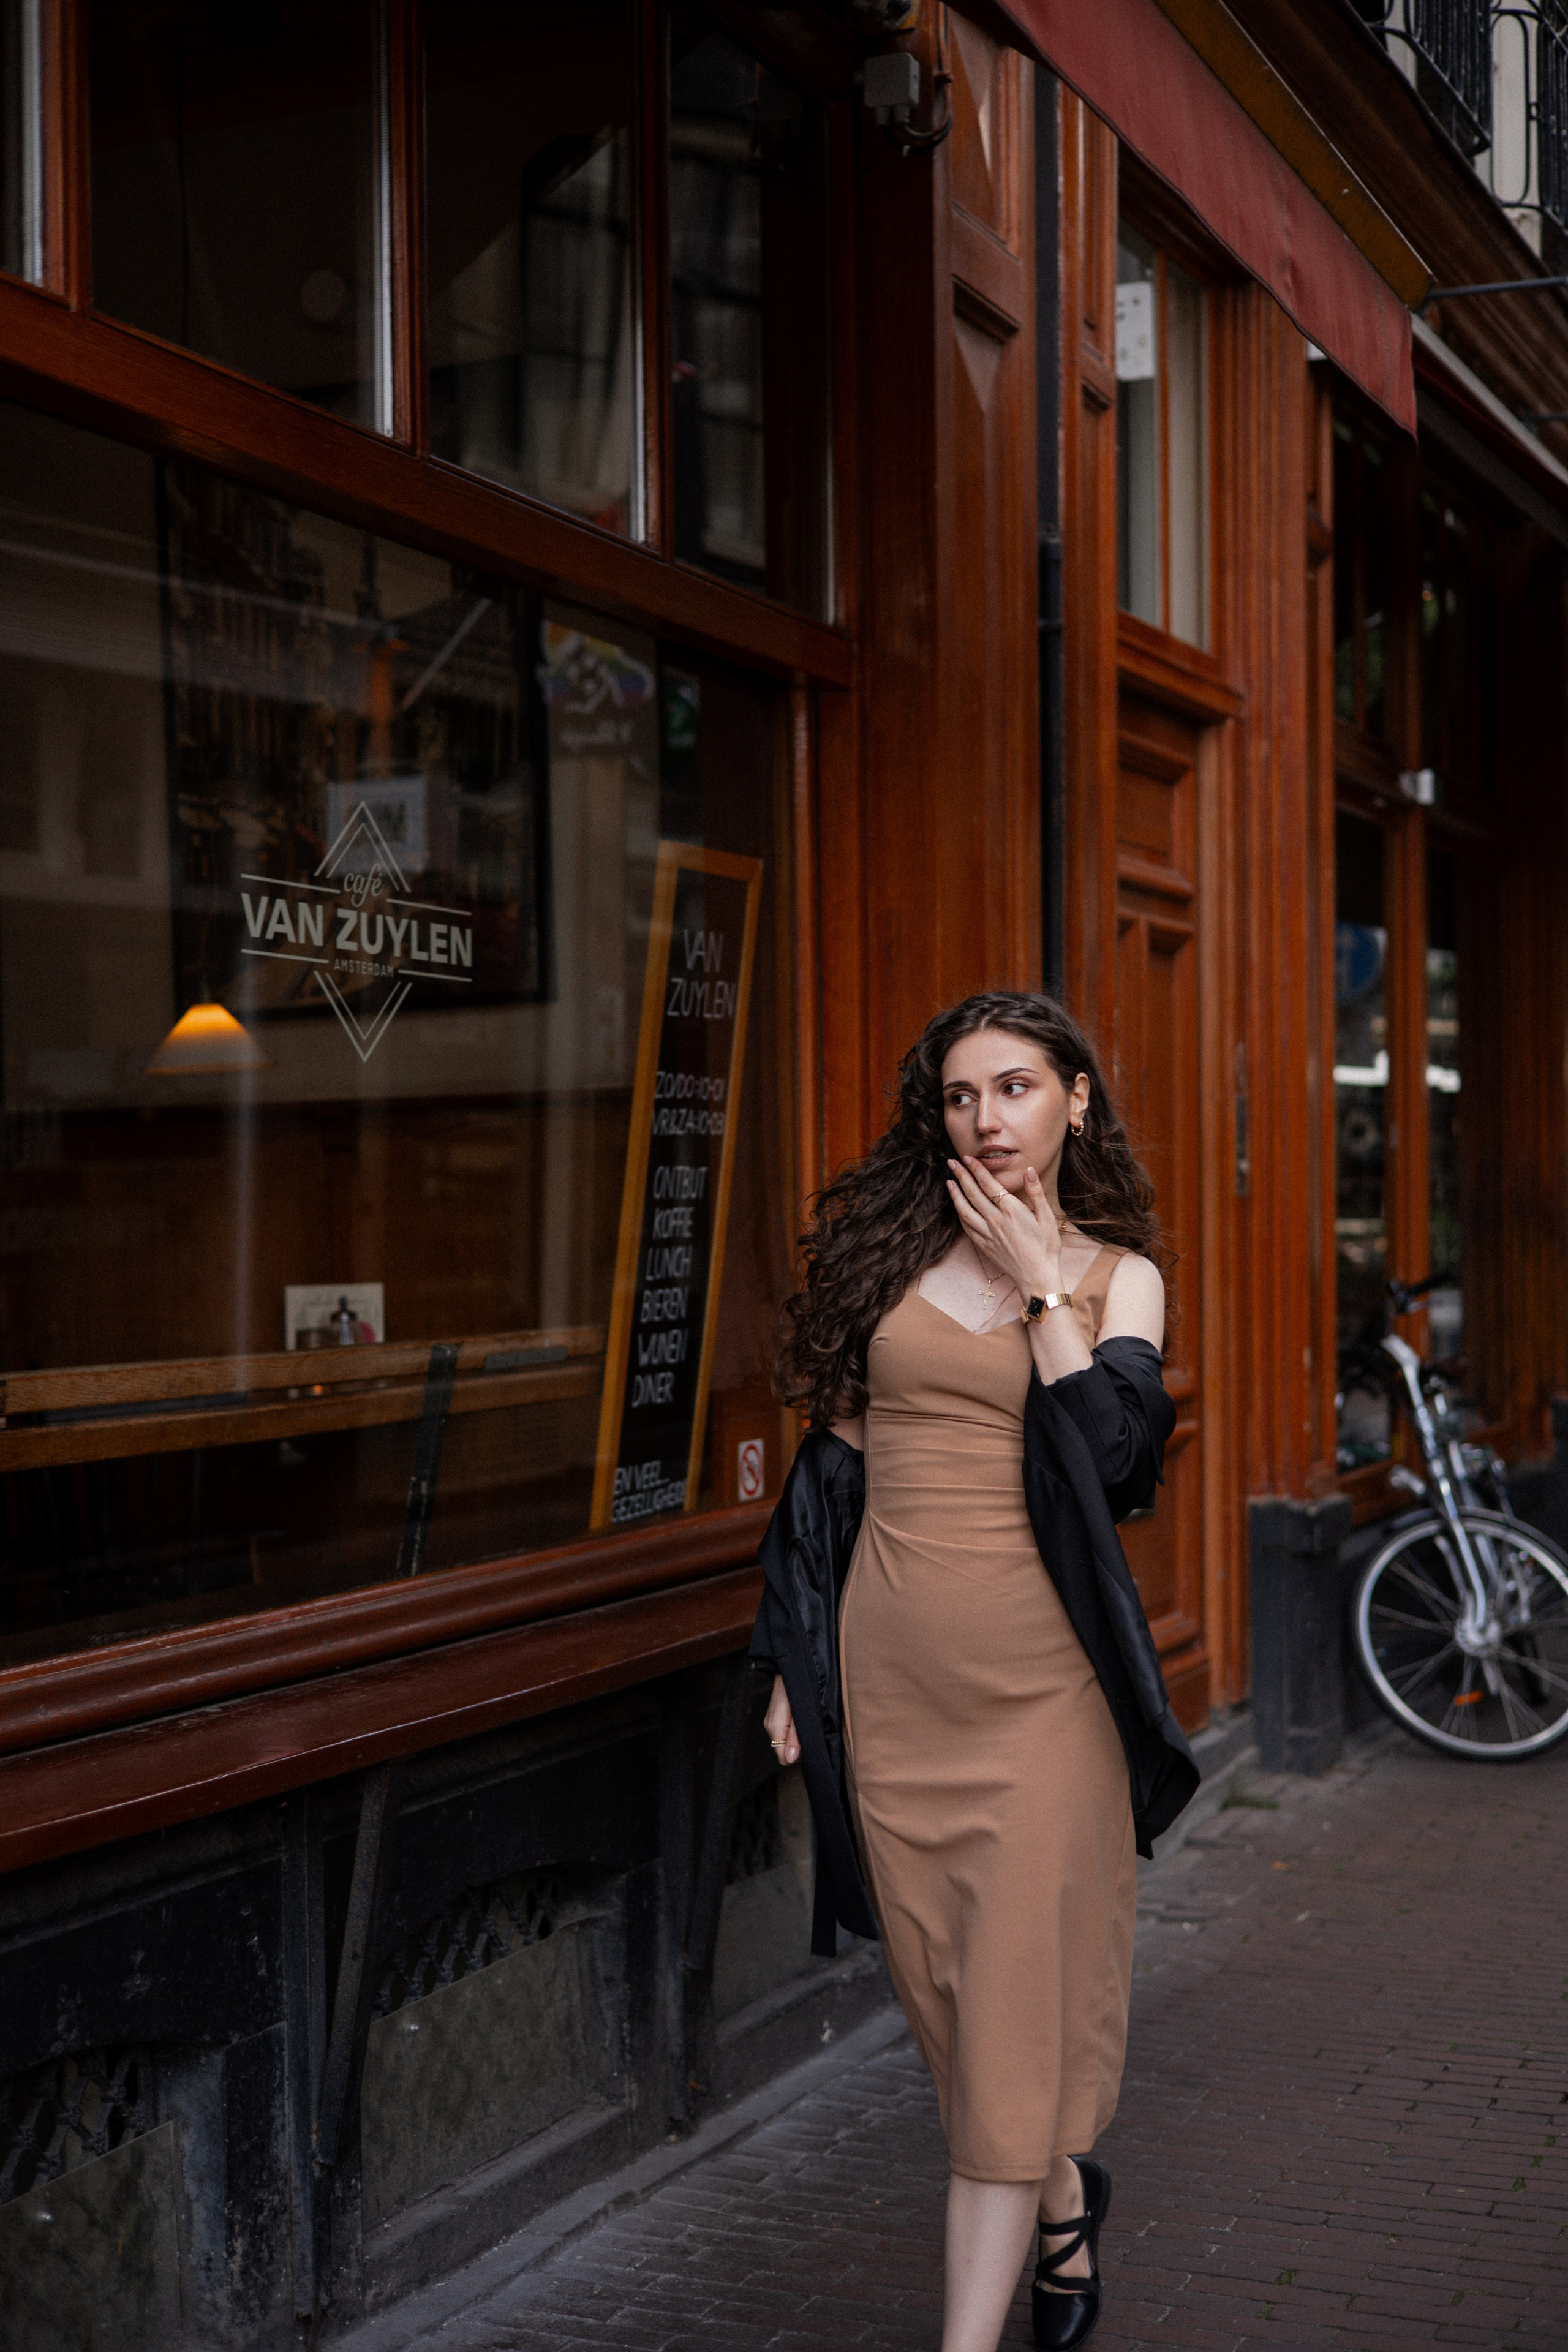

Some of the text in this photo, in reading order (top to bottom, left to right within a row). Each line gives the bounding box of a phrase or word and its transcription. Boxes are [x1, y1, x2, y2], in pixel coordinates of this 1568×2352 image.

[343, 862, 382, 907] café
[241, 892, 472, 967] VAN ZUYLEN
[334, 958, 394, 979] AMSTERDAM
[683, 929, 724, 973] VAN
[666, 977, 736, 1019] ZUYLEN
[645, 1245, 693, 1282] LUNCH
[639, 1286, 689, 1324] BIEREN
[631, 1370, 676, 1409] DINER
